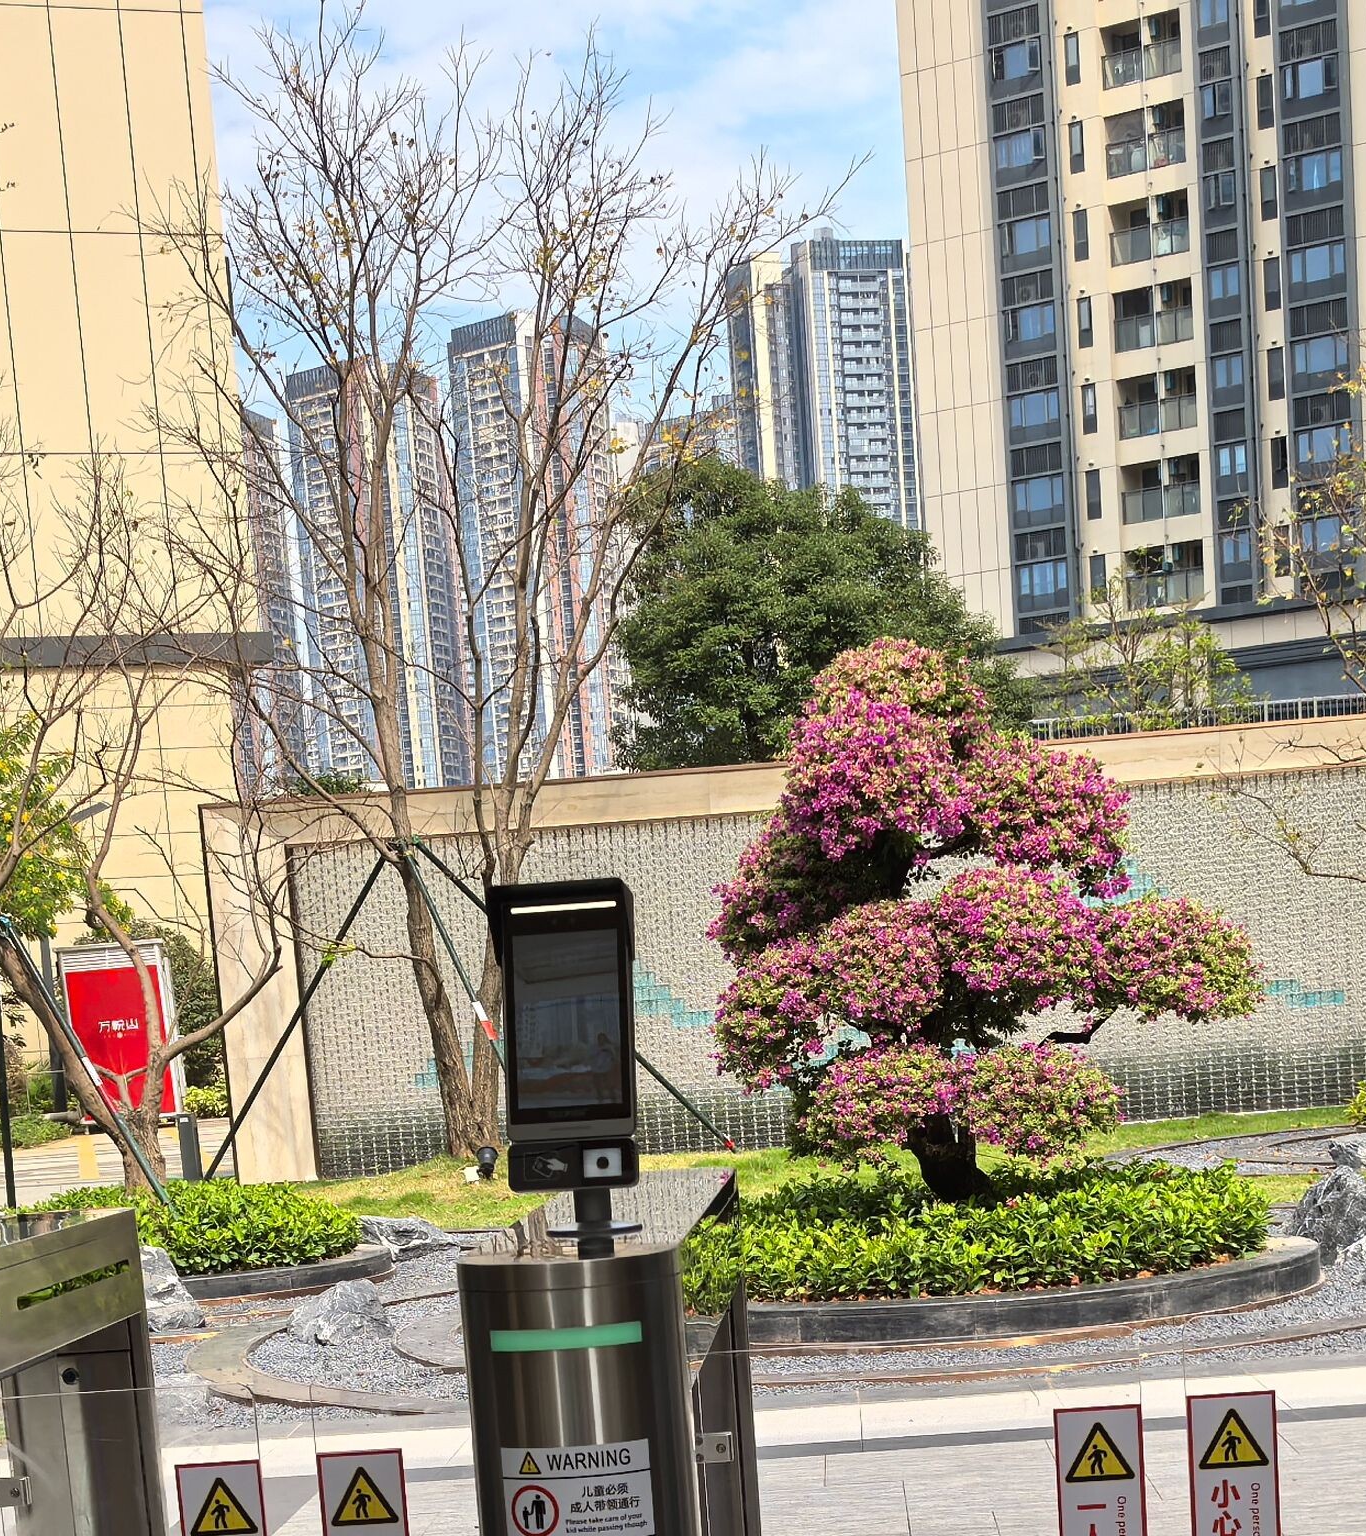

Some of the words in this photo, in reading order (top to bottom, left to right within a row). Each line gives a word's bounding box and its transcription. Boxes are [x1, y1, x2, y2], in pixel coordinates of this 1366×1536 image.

[546, 1448, 631, 1471] WARNING
[582, 1482, 629, 1498] 儿童必须
[570, 1496, 640, 1513] 成人带领通行
